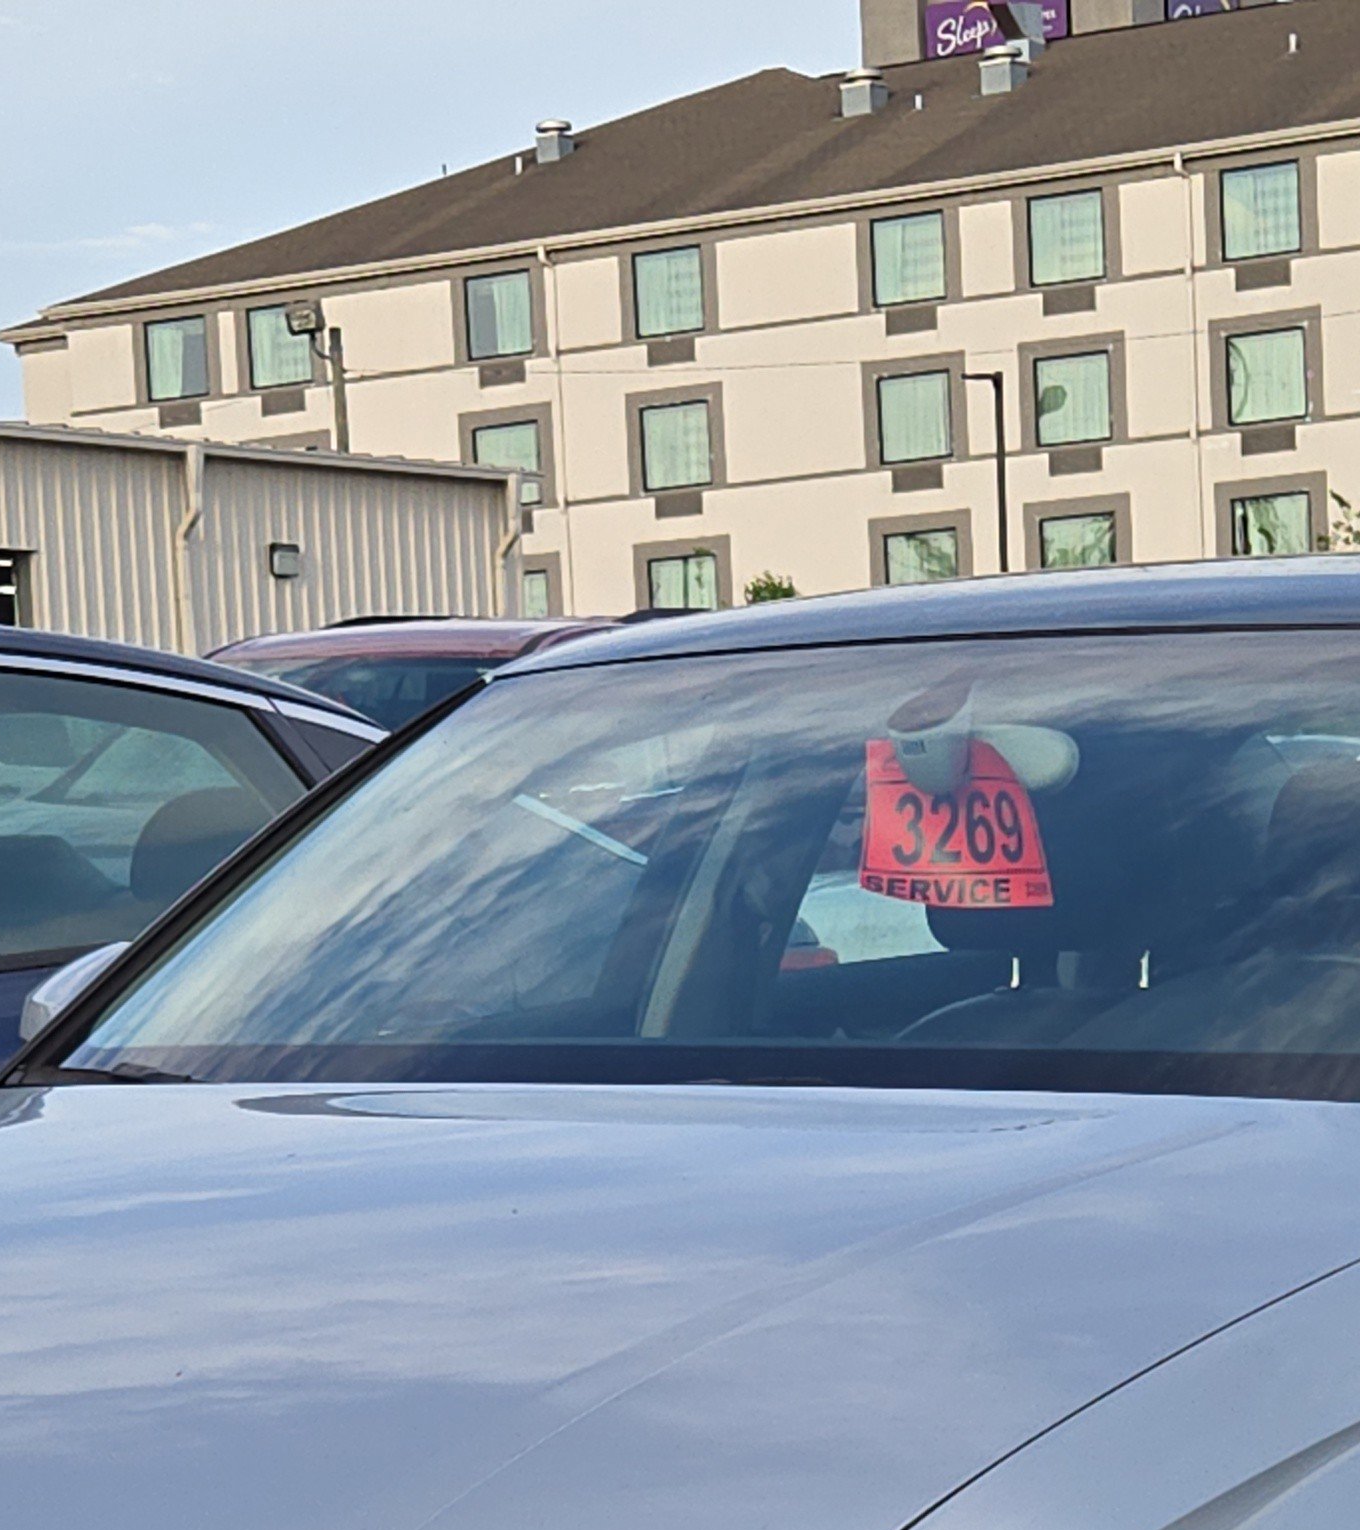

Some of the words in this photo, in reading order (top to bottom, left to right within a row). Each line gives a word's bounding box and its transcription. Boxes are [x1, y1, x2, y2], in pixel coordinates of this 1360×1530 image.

[937, 15, 991, 56] Sleep
[892, 789, 1024, 866] 3269
[864, 875, 1011, 902] SERVICE
